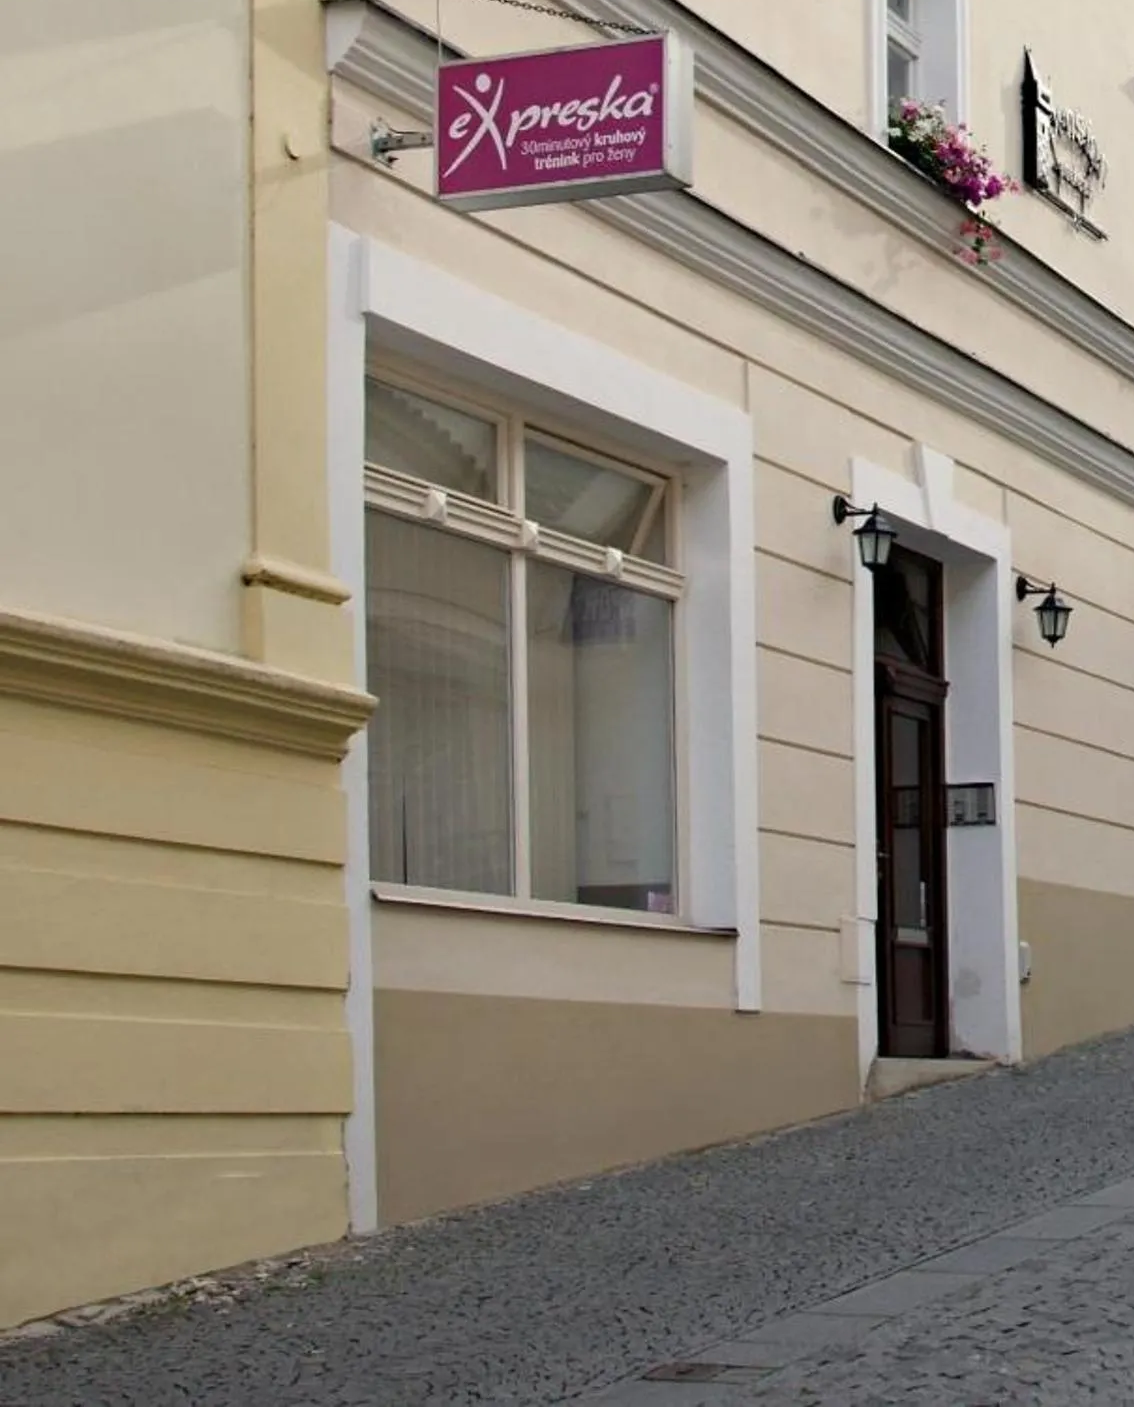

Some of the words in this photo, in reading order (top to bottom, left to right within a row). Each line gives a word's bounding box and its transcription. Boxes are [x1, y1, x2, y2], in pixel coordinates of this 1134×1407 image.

[594, 127, 646, 146] kruhový
[534, 152, 580, 170] trénink
[582, 151, 605, 168] pro
[607, 146, 637, 162] ženy
